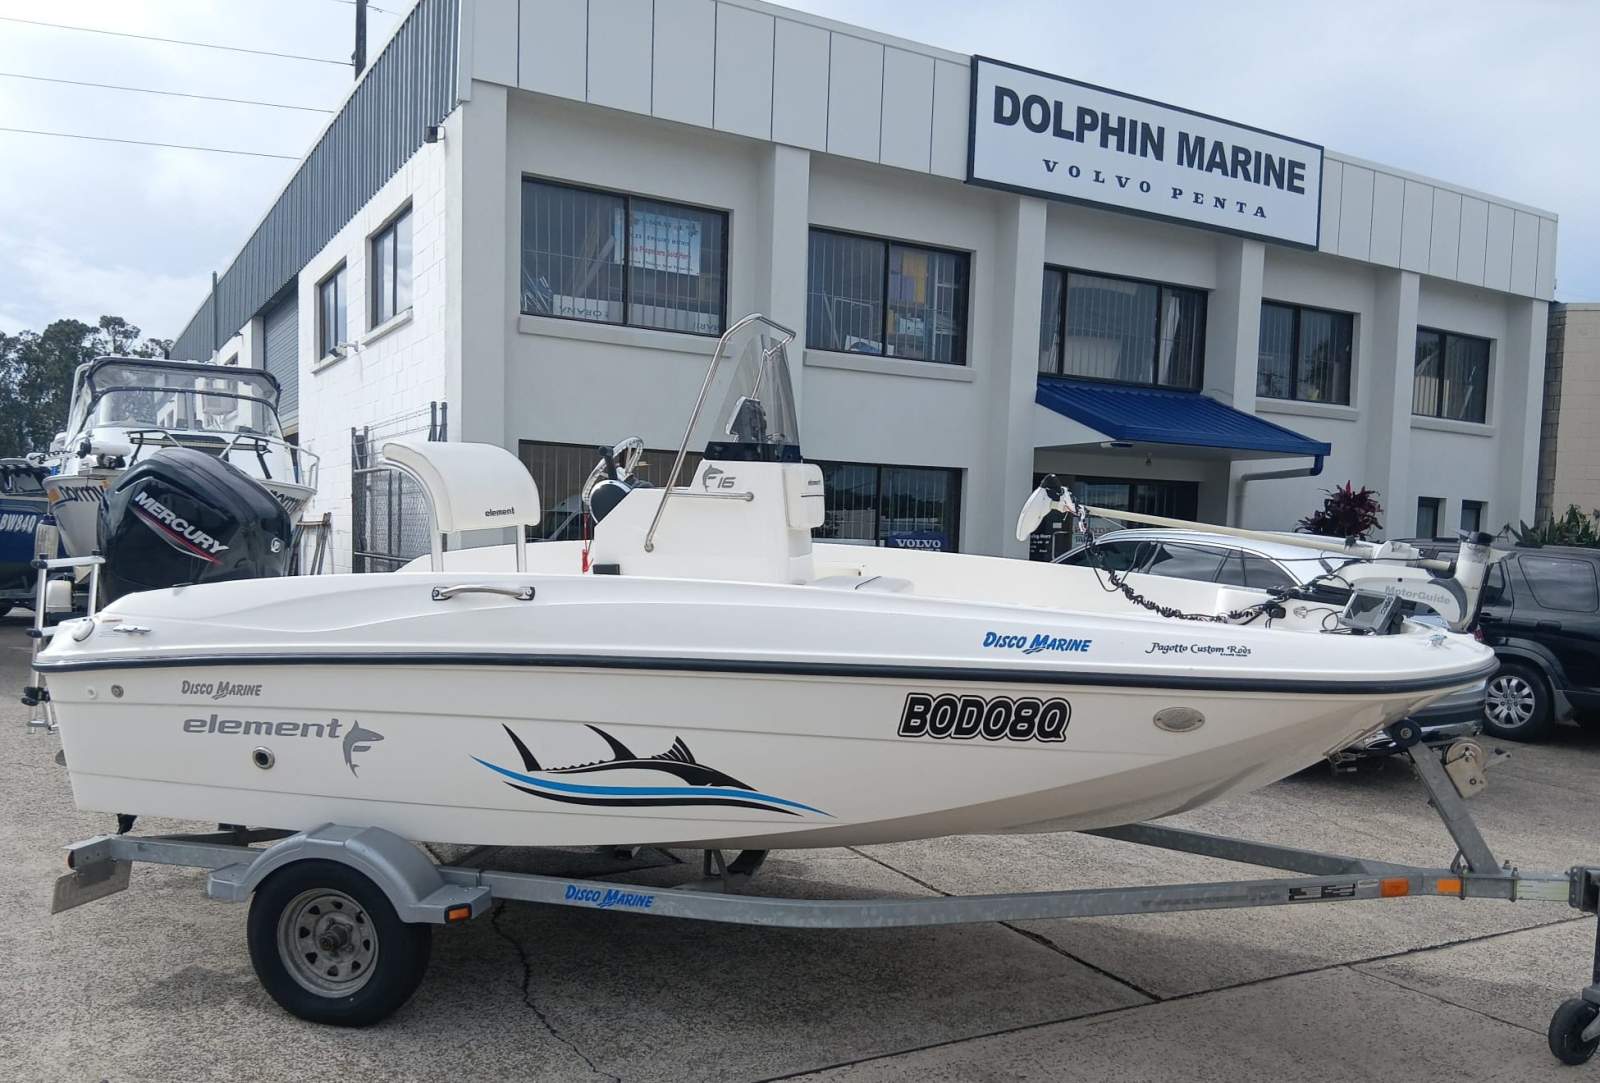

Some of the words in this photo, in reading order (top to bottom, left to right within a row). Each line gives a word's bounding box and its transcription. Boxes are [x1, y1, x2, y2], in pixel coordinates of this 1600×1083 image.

[993, 85, 1165, 162] DOLPHIN
[1176, 130, 1306, 195] MARINE
[1042, 158, 1151, 193] VOLVO
[1171, 187, 1267, 219] PENTA
[134, 491, 230, 553] MERCURY
[484, 506, 515, 517] element
[0, 513, 37, 533] BW840
[895, 538, 942, 548] VOLVO
[1385, 584, 1450, 605] MotorGuide
[1145, 642, 1188, 654] Pagotto
[1190, 644, 1224, 654] Custom
[1226, 645, 1252, 655] Rods
[183, 714, 343, 738] element
